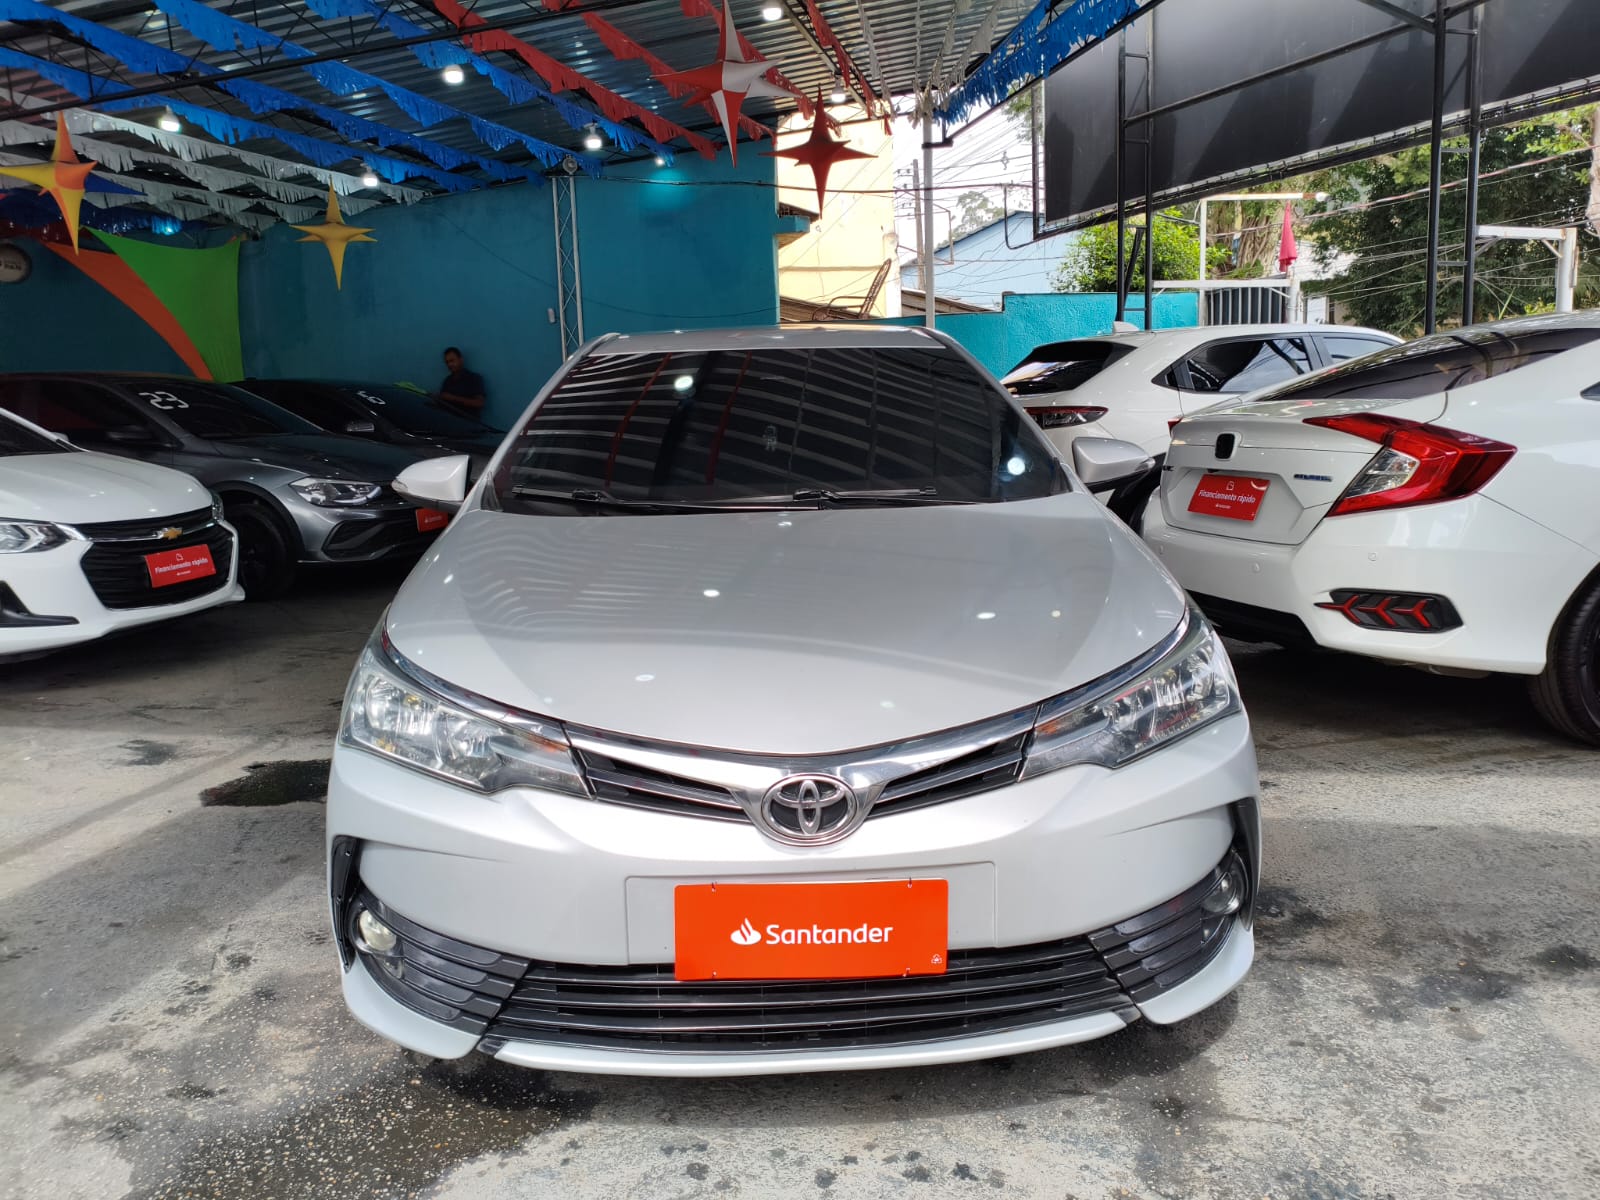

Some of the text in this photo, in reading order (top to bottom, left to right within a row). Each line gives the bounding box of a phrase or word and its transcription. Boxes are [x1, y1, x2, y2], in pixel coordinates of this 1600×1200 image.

[138, 391, 189, 410] 23
[1198, 489, 1237, 501] Financiamento
[154, 561, 192, 574] Financiamento
[766, 923, 893, 945] Santander
